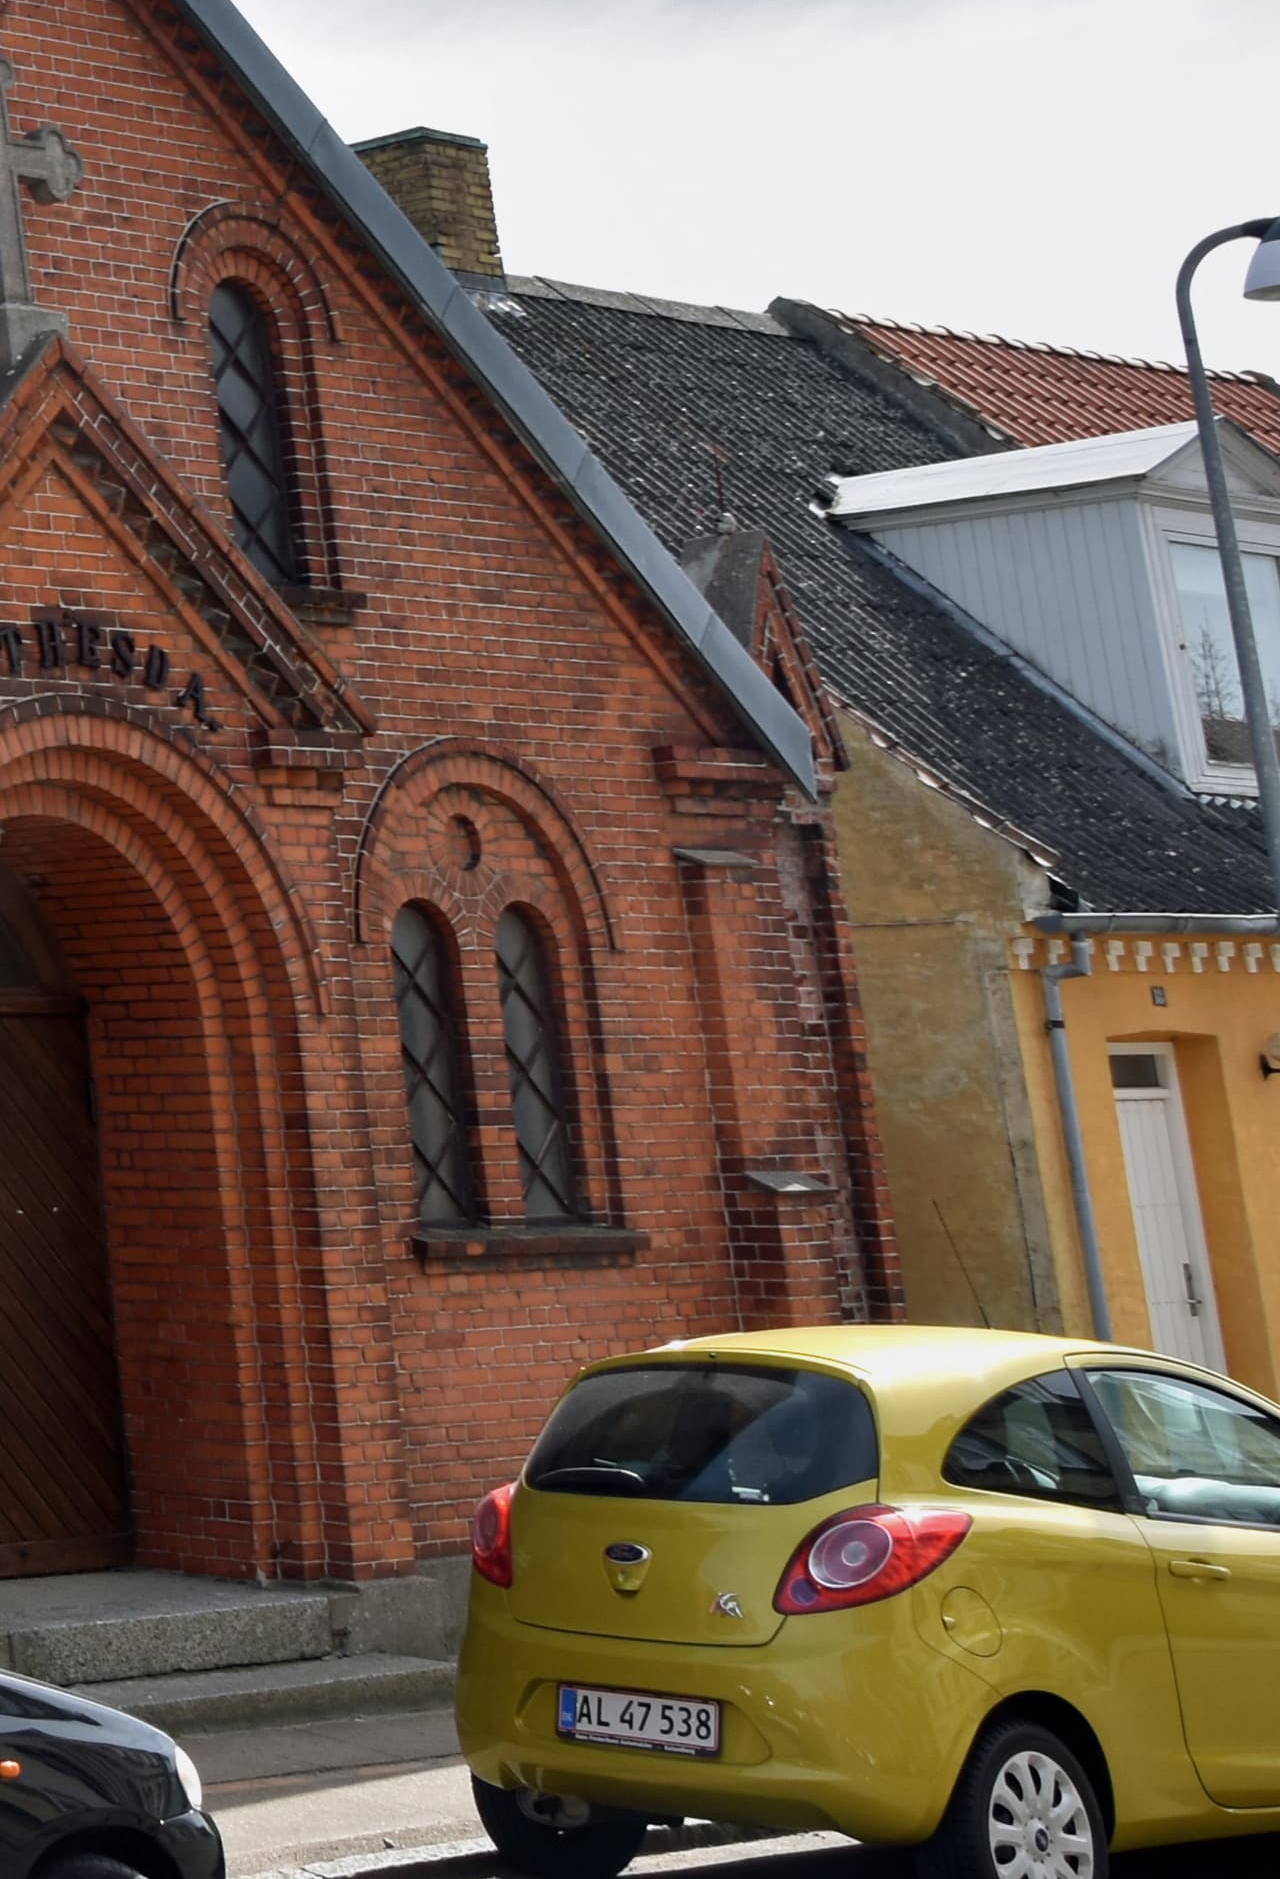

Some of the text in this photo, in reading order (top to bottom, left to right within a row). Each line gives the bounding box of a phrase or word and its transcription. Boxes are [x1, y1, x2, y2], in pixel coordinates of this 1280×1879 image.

[576, 1695, 712, 1741] AL 47 538
